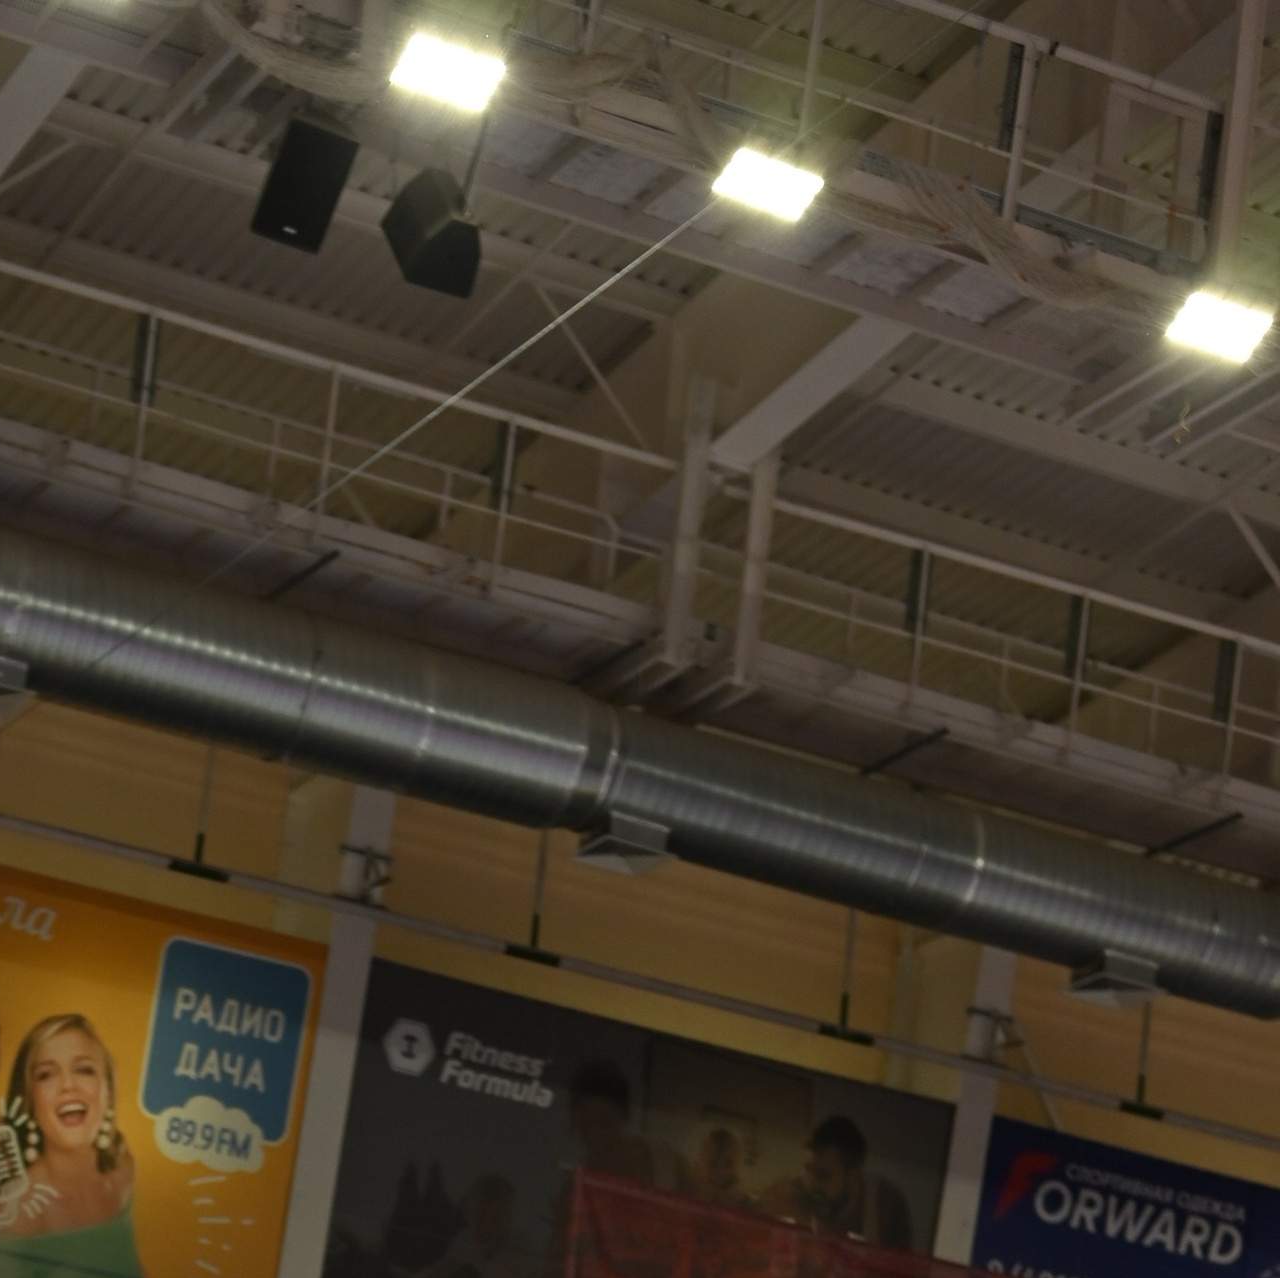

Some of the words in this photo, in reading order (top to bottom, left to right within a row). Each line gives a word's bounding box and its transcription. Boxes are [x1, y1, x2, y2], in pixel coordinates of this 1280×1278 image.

[173, 987, 286, 1044] РАДИО
[173, 1042, 266, 1093] ДАЧА
[444, 1031, 546, 1077] Fitness
[439, 1059, 554, 1108] Formula
